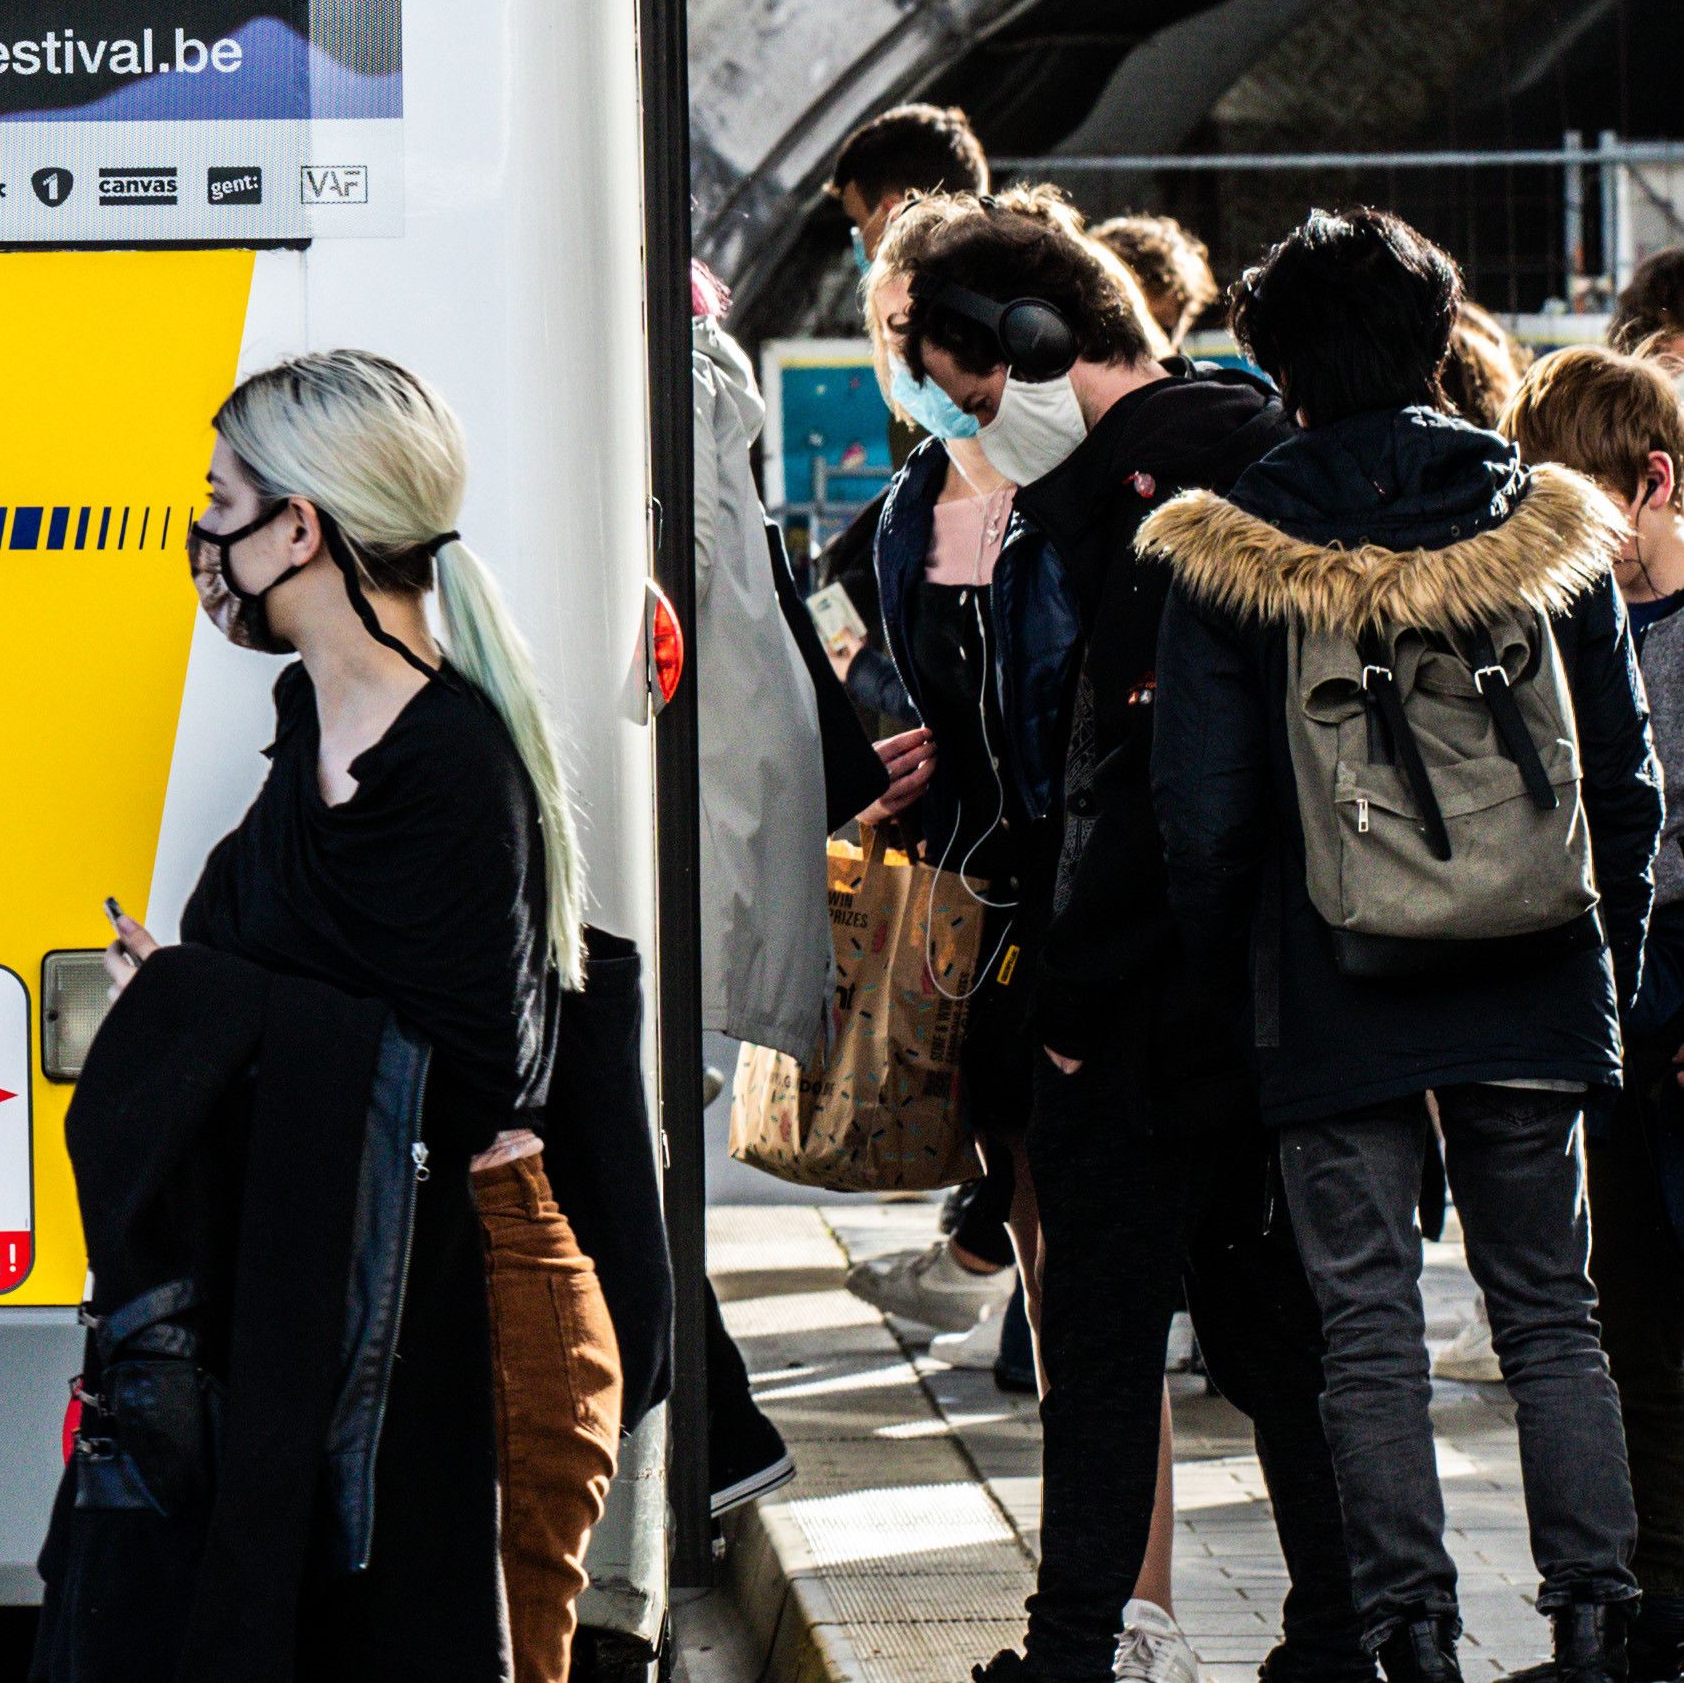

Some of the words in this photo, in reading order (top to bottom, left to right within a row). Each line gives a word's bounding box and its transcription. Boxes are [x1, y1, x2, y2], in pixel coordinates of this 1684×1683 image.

[99, 176, 177, 194] canvas
[210, 175, 259, 200] gent:
[306, 170, 361, 198] VAF
